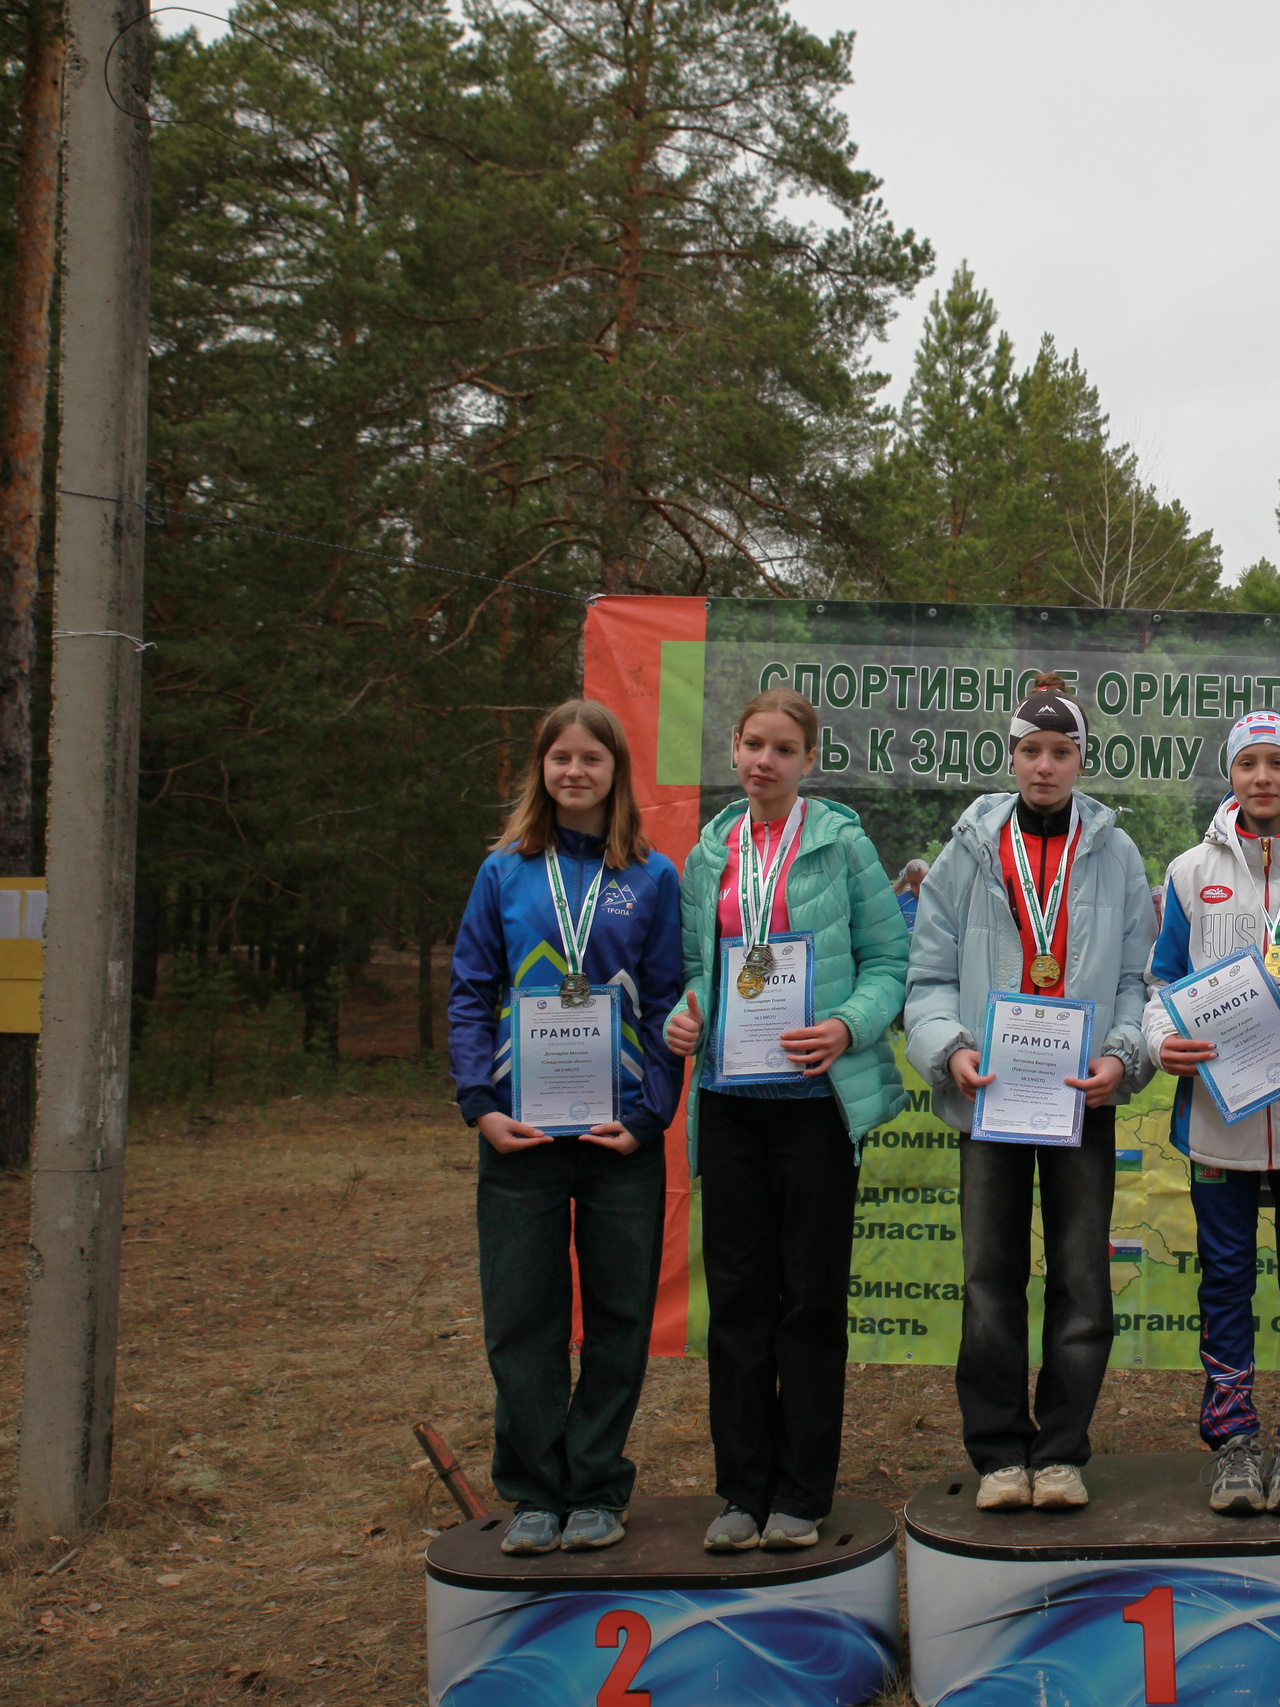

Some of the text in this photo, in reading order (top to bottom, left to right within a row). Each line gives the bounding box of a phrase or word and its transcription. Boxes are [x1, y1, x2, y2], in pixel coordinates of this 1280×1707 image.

[868, 728, 896, 773] К
[909, 729, 1203, 783] ЗДОВОМУ
[607, 907, 630, 916] ТРОПА
[1194, 988, 1259, 1028] ГРАМОТА
[530, 1027, 600, 1039] ГРАМОТА
[1002, 1034, 1070, 1050] ГРАМОТА
[595, 1609, 651, 1707] 2
[1122, 1585, 1176, 1705] 1
